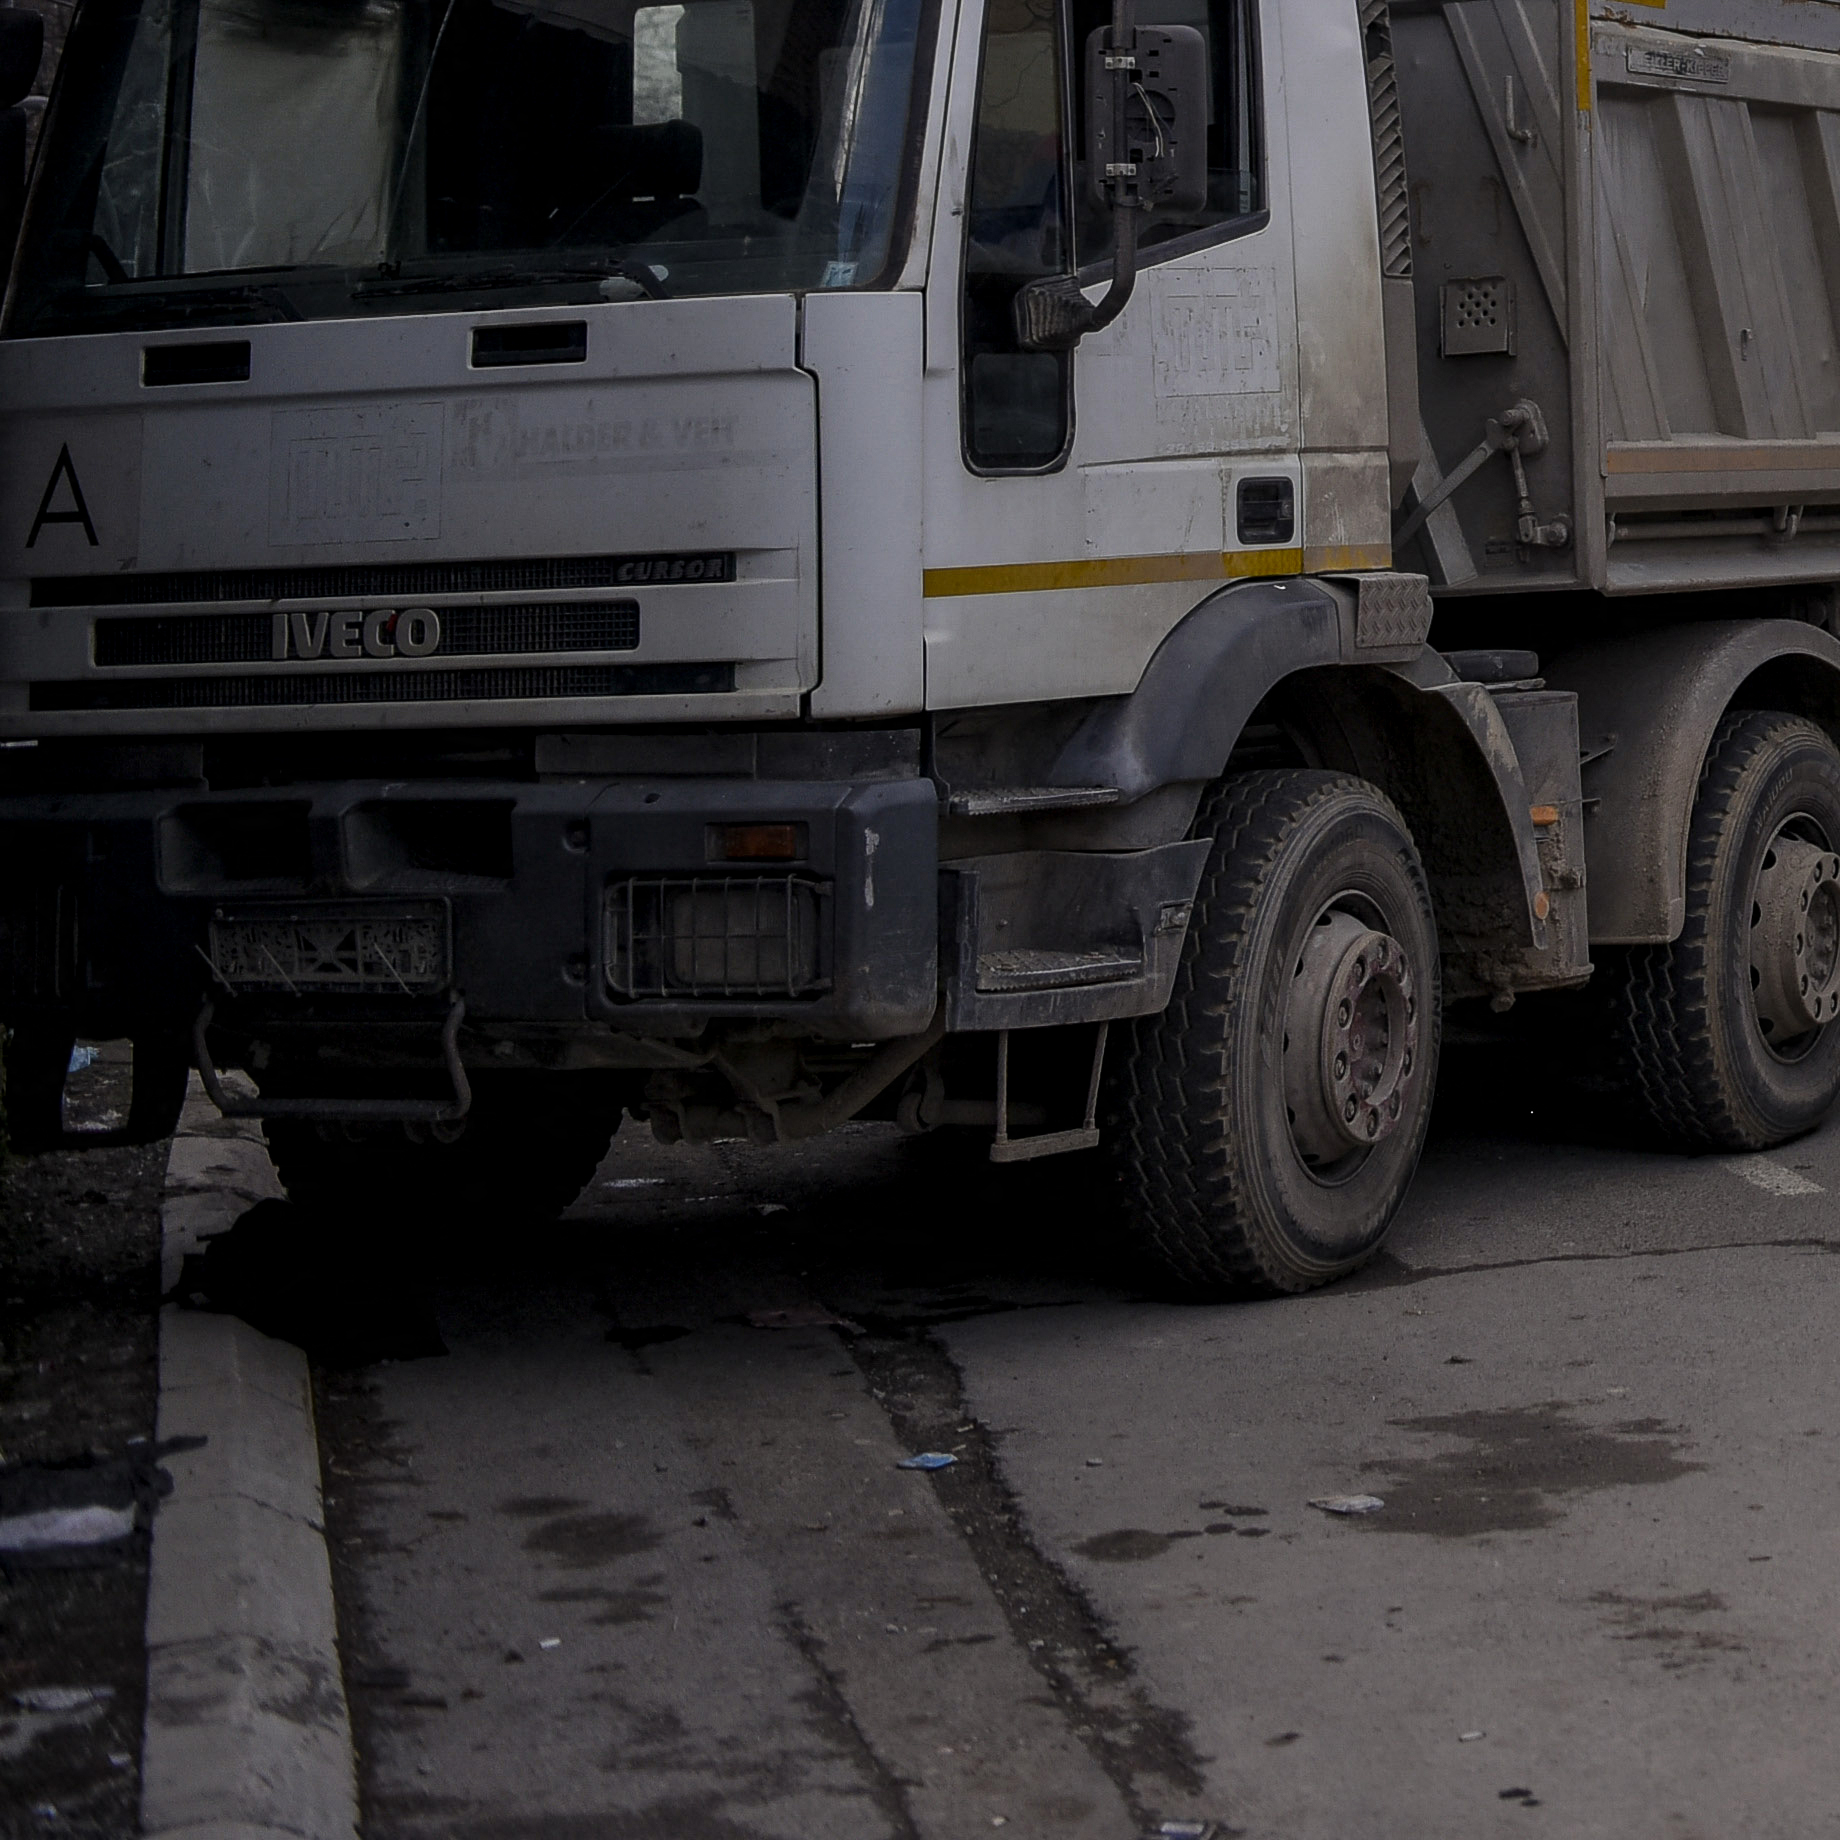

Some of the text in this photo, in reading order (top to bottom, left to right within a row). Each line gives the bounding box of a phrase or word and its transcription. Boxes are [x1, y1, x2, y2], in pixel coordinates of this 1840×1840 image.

[25, 441, 100, 549] A
[616, 558, 724, 582] CURSOR
[272, 607, 442, 660] IVECO
